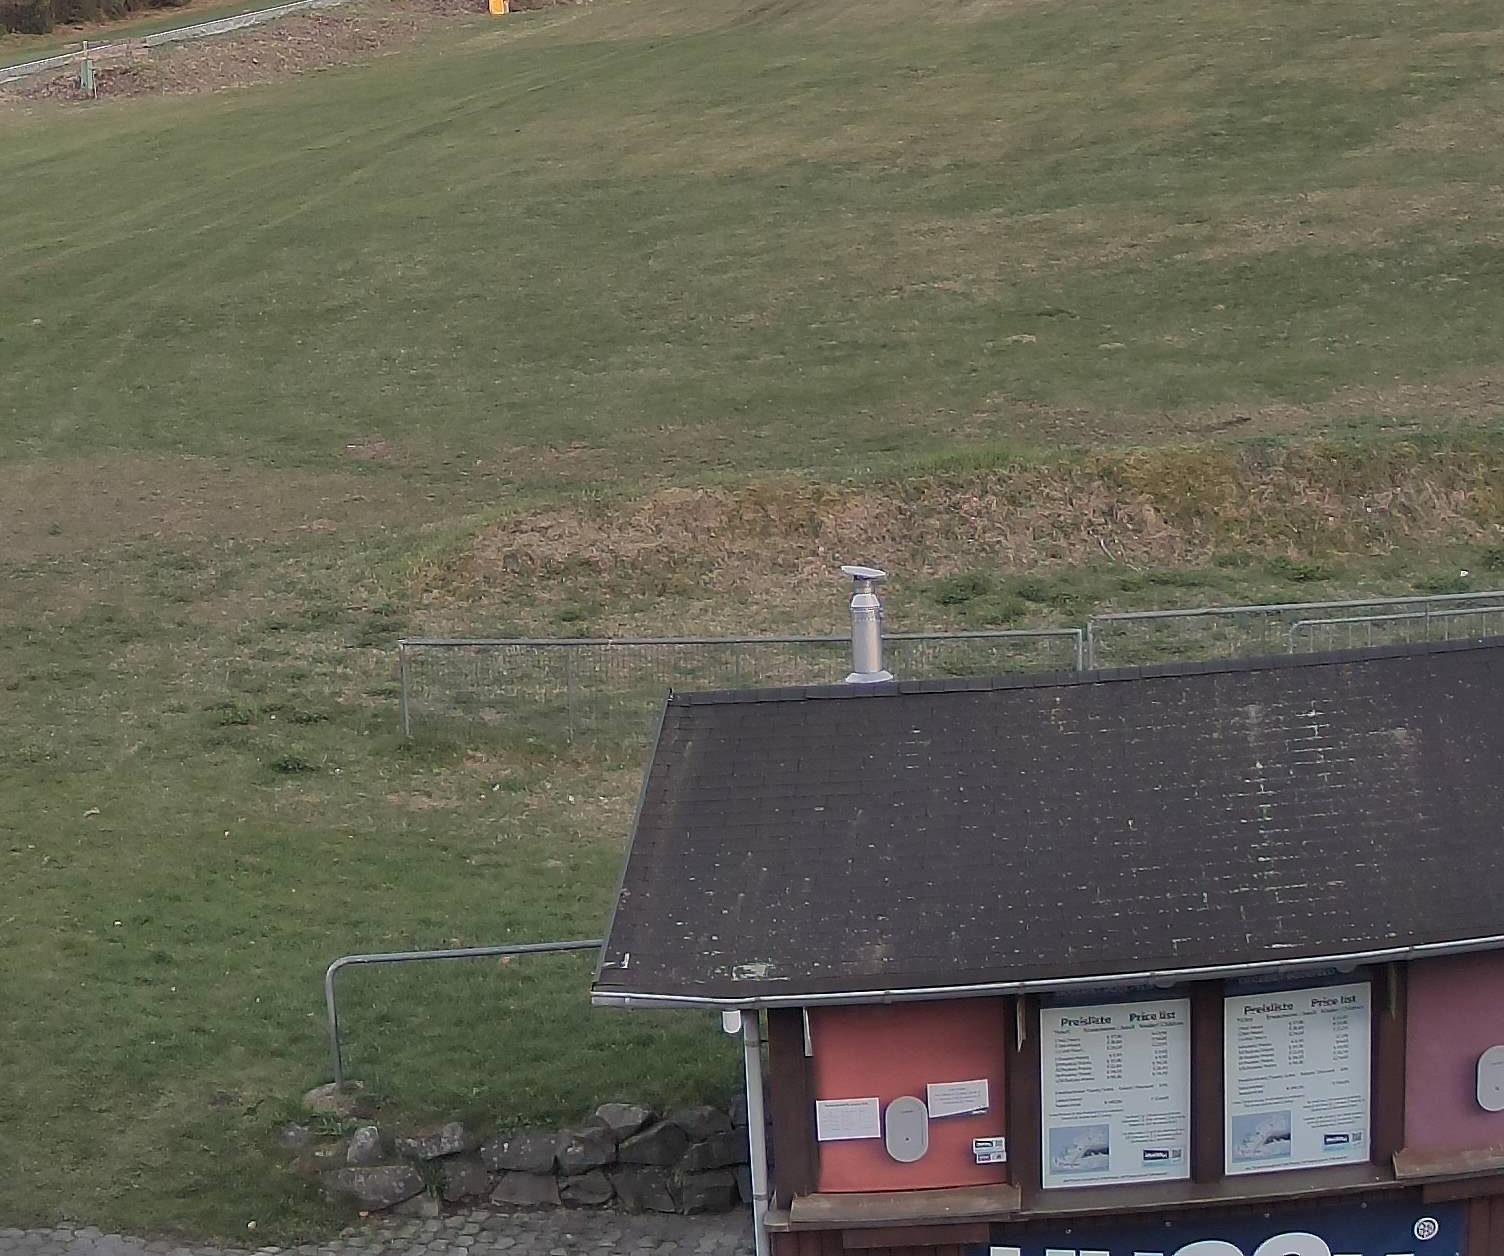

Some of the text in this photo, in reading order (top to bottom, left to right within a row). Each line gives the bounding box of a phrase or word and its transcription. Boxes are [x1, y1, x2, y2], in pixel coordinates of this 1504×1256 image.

[1311, 997, 1338, 1008] Price
[1340, 995, 1356, 1004] list
[1129, 1011, 1157, 1022] Price
[1159, 1010, 1176, 1020] list
